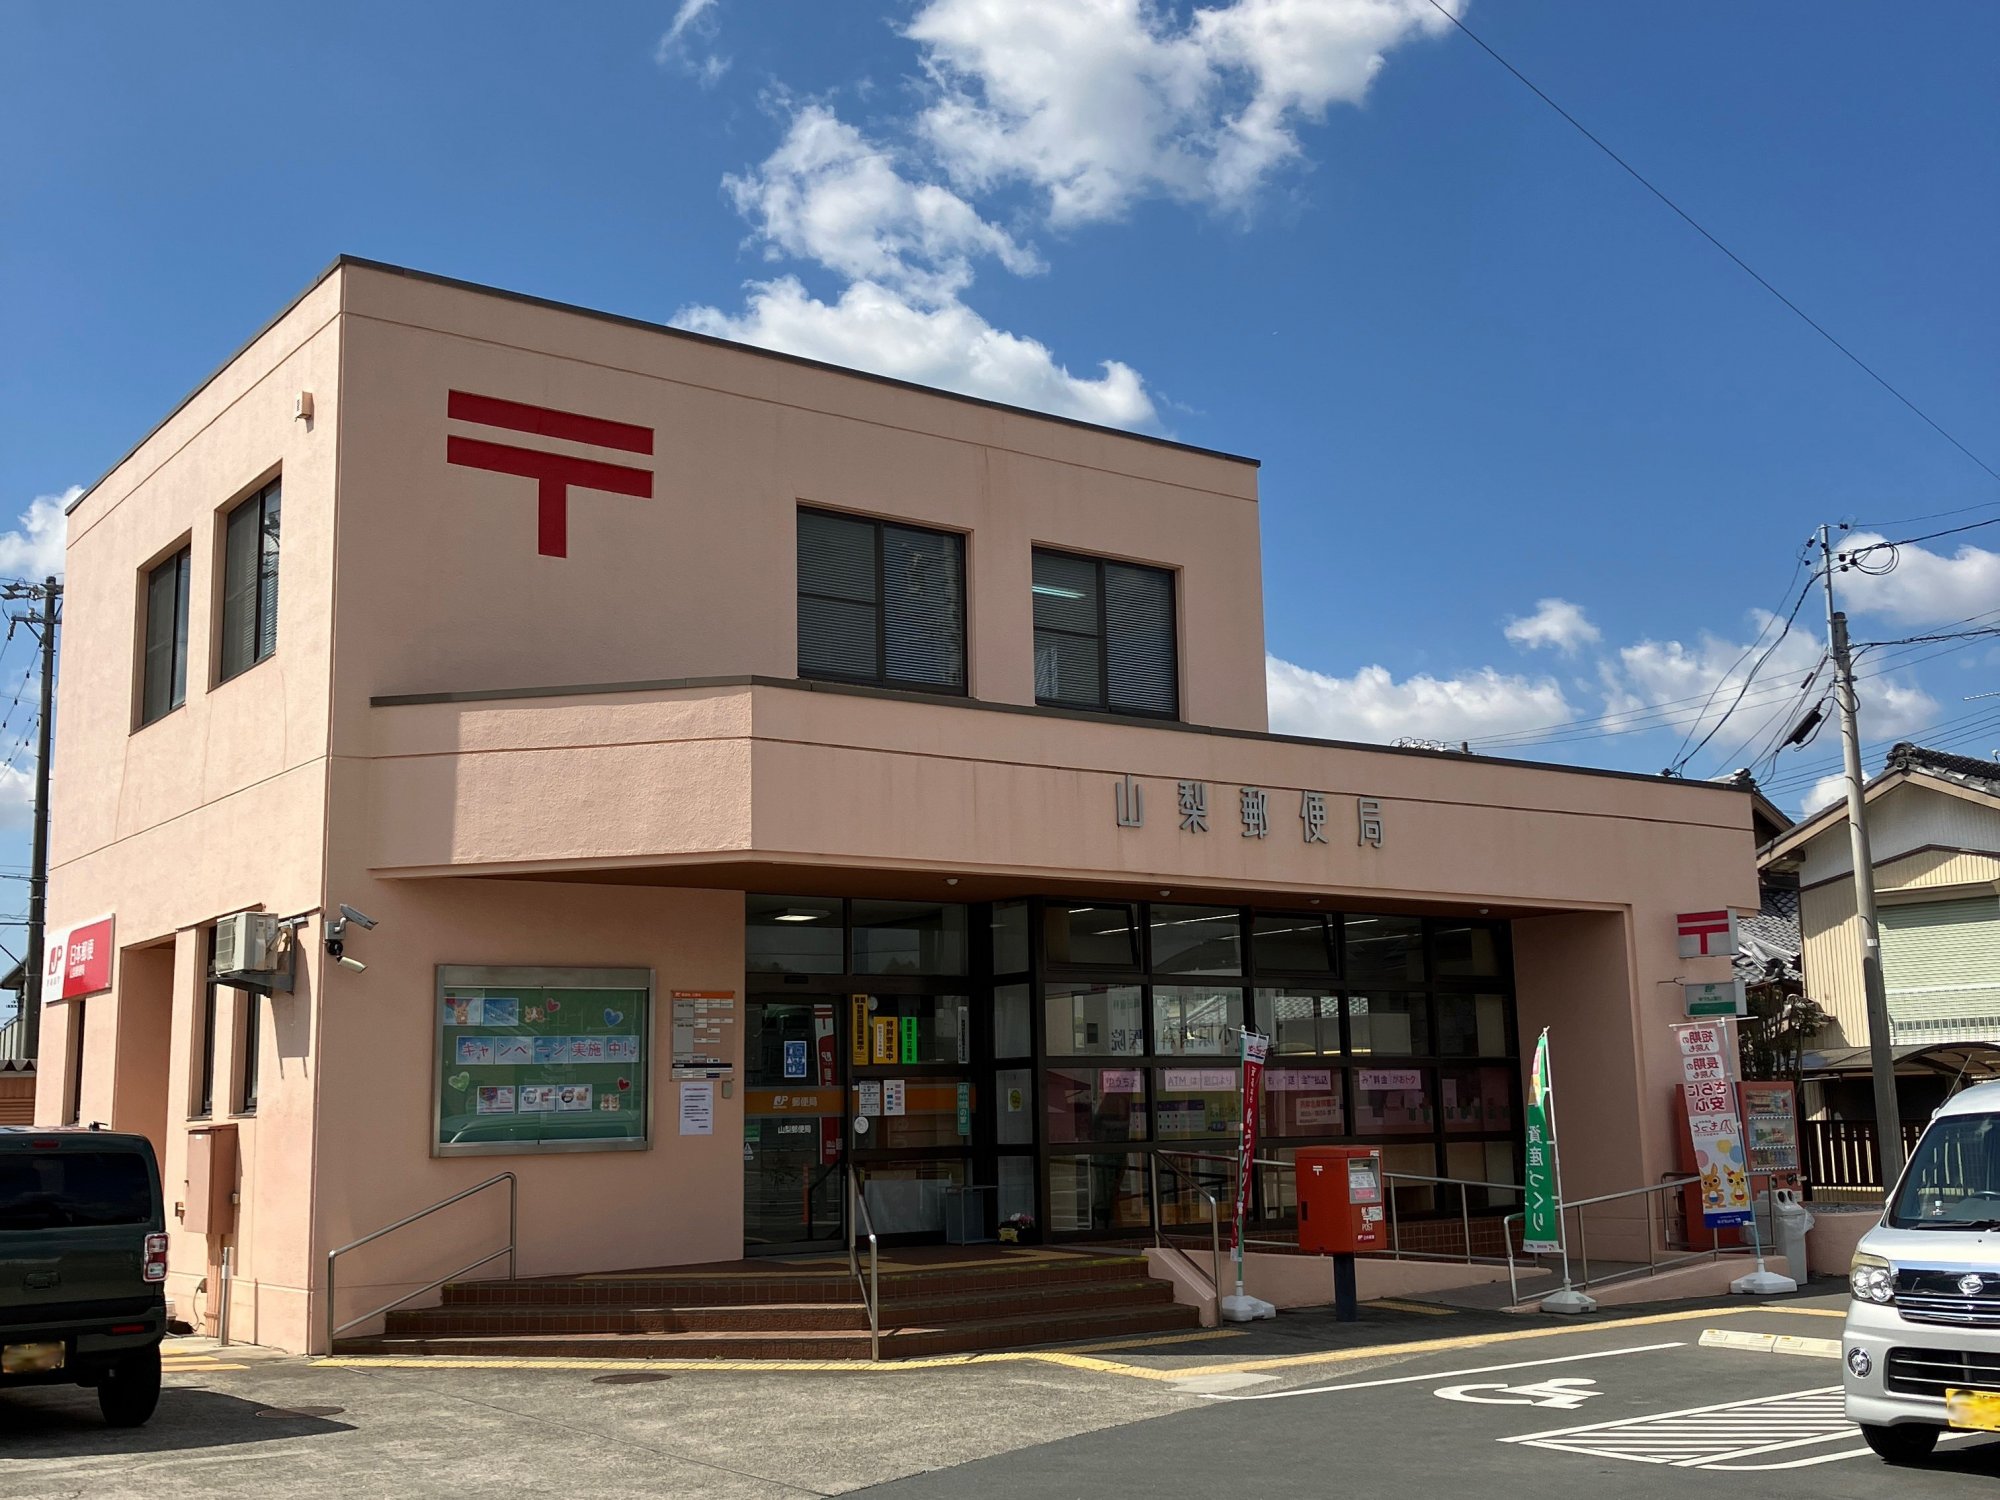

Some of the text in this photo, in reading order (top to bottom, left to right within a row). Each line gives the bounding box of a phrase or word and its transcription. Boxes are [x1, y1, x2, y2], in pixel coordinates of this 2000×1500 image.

[1115, 773, 1385, 849] 山梨郵便局
[71, 940, 94, 965] 日本郵便
[792, 1096, 818, 1107] 郵便局
[777, 1124, 812, 1135] 山梨郵便局
[1361, 1222, 1373, 1232] POST
